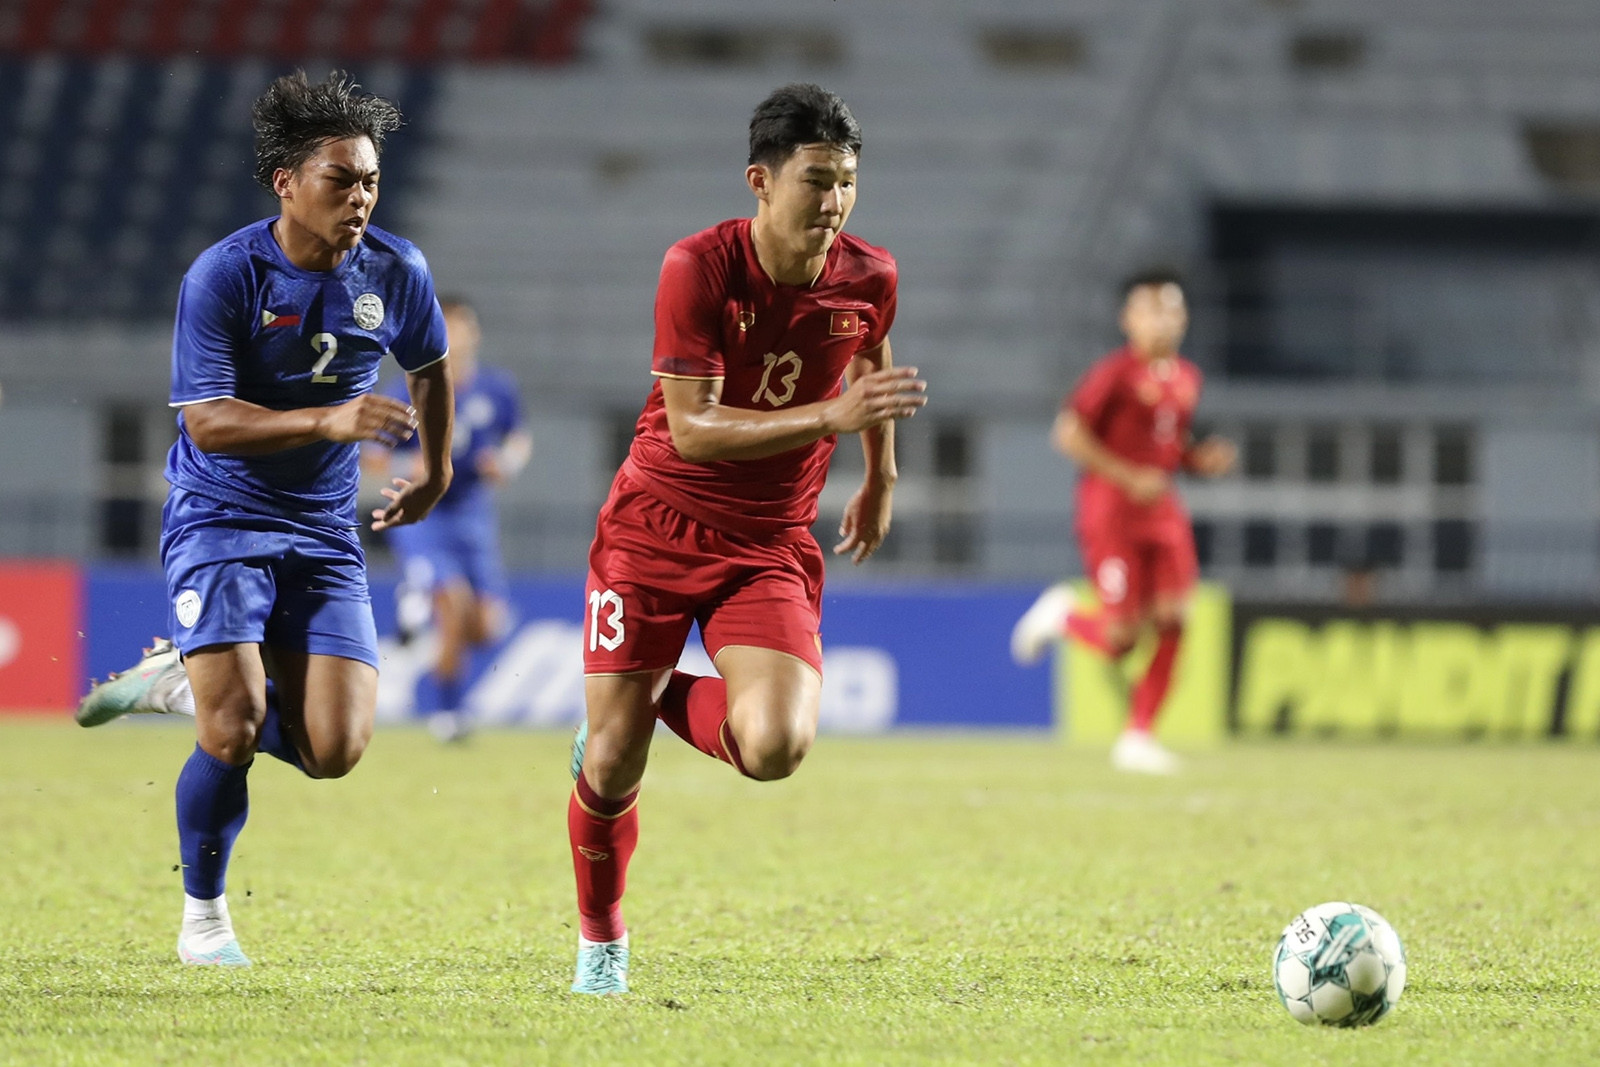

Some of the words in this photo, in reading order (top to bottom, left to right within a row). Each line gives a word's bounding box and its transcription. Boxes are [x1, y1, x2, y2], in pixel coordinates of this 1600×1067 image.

[310, 332, 338, 383] 2
[751, 350, 803, 407] 13
[588, 588, 625, 652] 13
